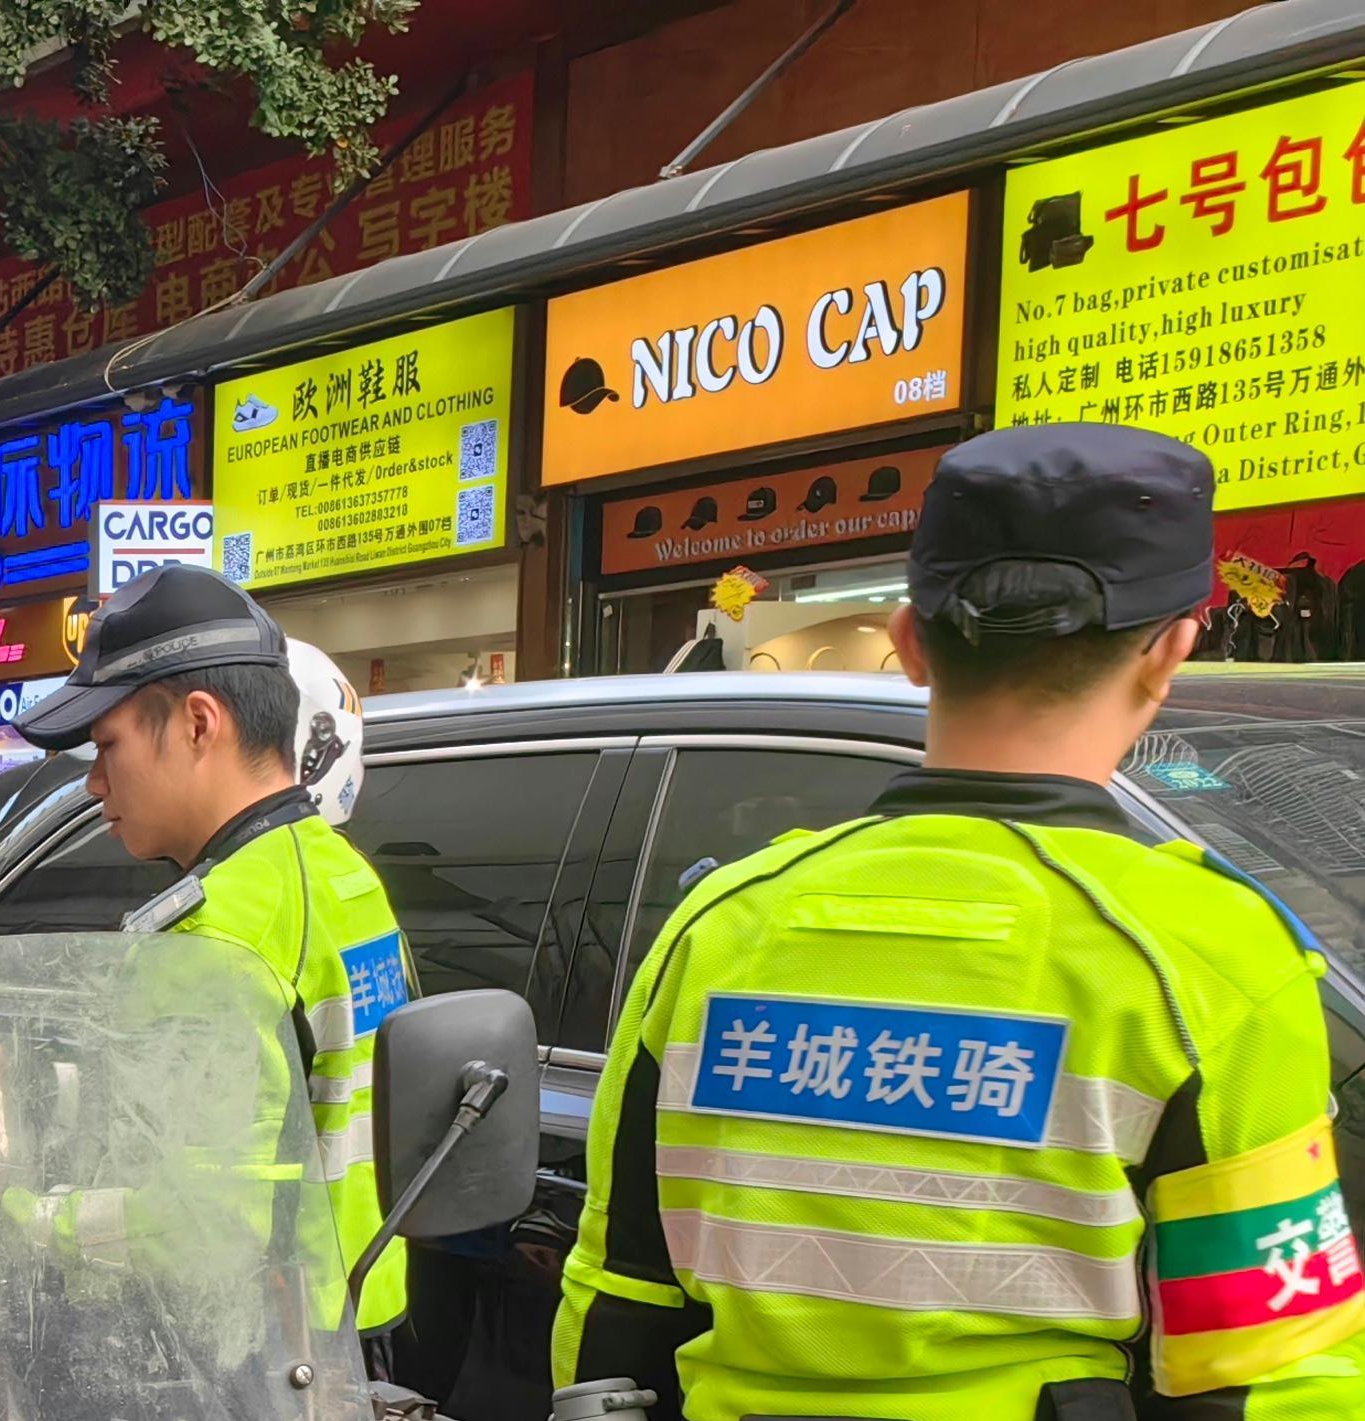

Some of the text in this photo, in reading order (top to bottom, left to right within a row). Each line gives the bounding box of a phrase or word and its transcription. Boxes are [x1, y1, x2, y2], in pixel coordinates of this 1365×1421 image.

[359, 166, 513, 260] 写字楼
[631, 266, 947, 409] NICO CAP
[1014, 335, 1060, 362] high
[1221, 292, 1307, 326] luxury
[1015, 295, 1066, 324] No.7
[292, 350, 422, 422] 欧洲鞋服
[893, 370, 948, 404] 08档
[1011, 323, 1327, 402] 私人定制 电话15918651358
[227, 386, 494, 463] EUROPEAN FOOTWEAR AND CLOTHING
[305, 435, 402, 474] 直播电商供应链
[1203, 418, 1277, 446] Outer
[104, 510, 213, 541] CARGO
[655, 532, 744, 562] Welcome
[747, 528, 766, 548] to
[771, 515, 831, 545] order
[836, 514, 872, 536] our
[713, 1019, 1035, 1117] 羊城铁骑
[1255, 1190, 1360, 1312] 交警
